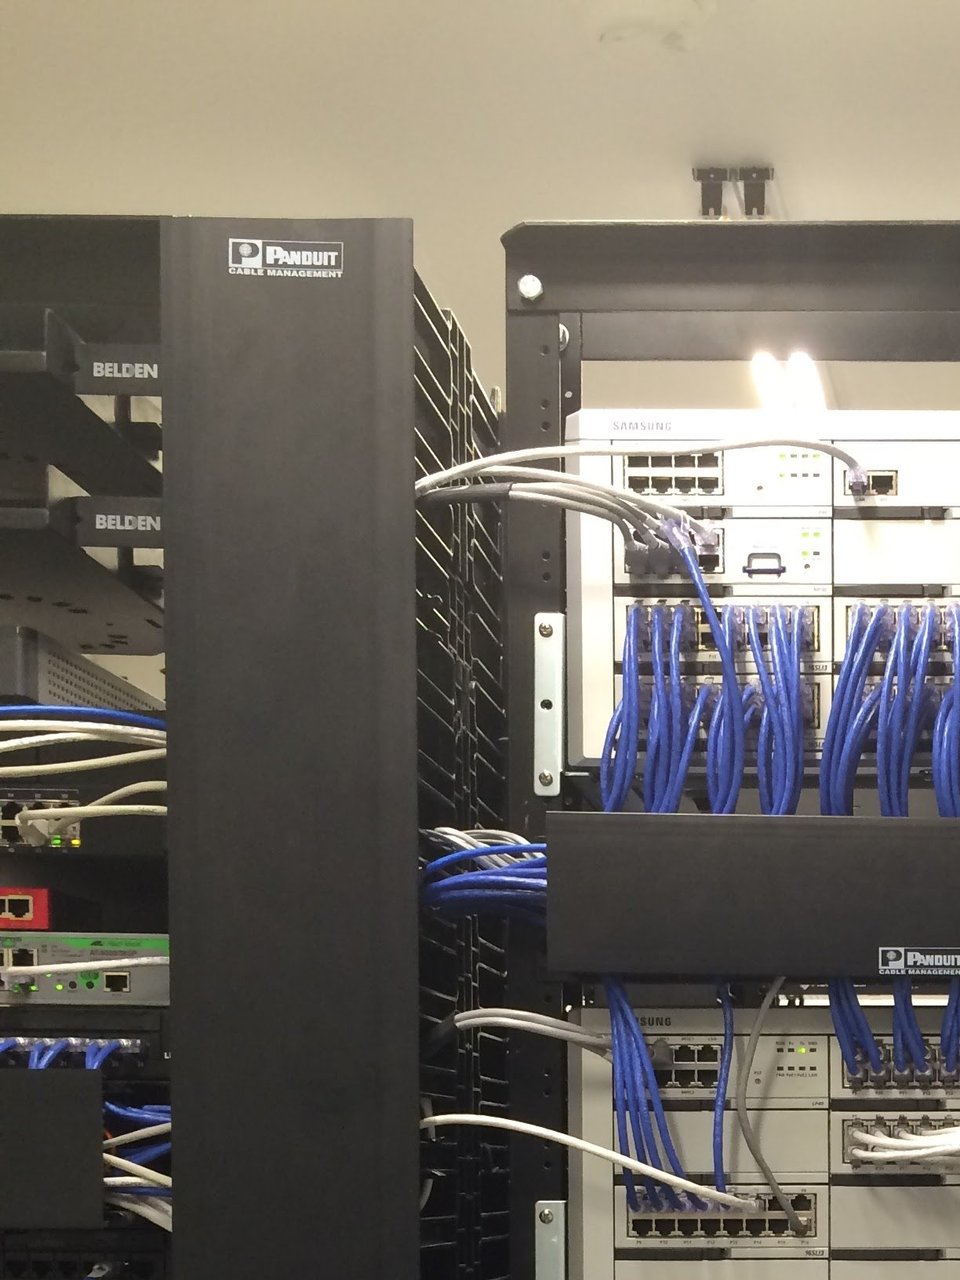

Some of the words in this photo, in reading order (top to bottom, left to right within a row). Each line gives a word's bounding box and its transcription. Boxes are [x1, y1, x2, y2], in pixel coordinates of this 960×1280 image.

[266, 246, 338, 266] PANDUIT
[229, 267, 264, 276] CABLE
[267, 269, 343, 278] MANAGEMENT
[93, 362, 158, 379] BELDEN
[612, 421, 672, 431] SAMSUNG
[95, 514, 161, 531] BELDEN
